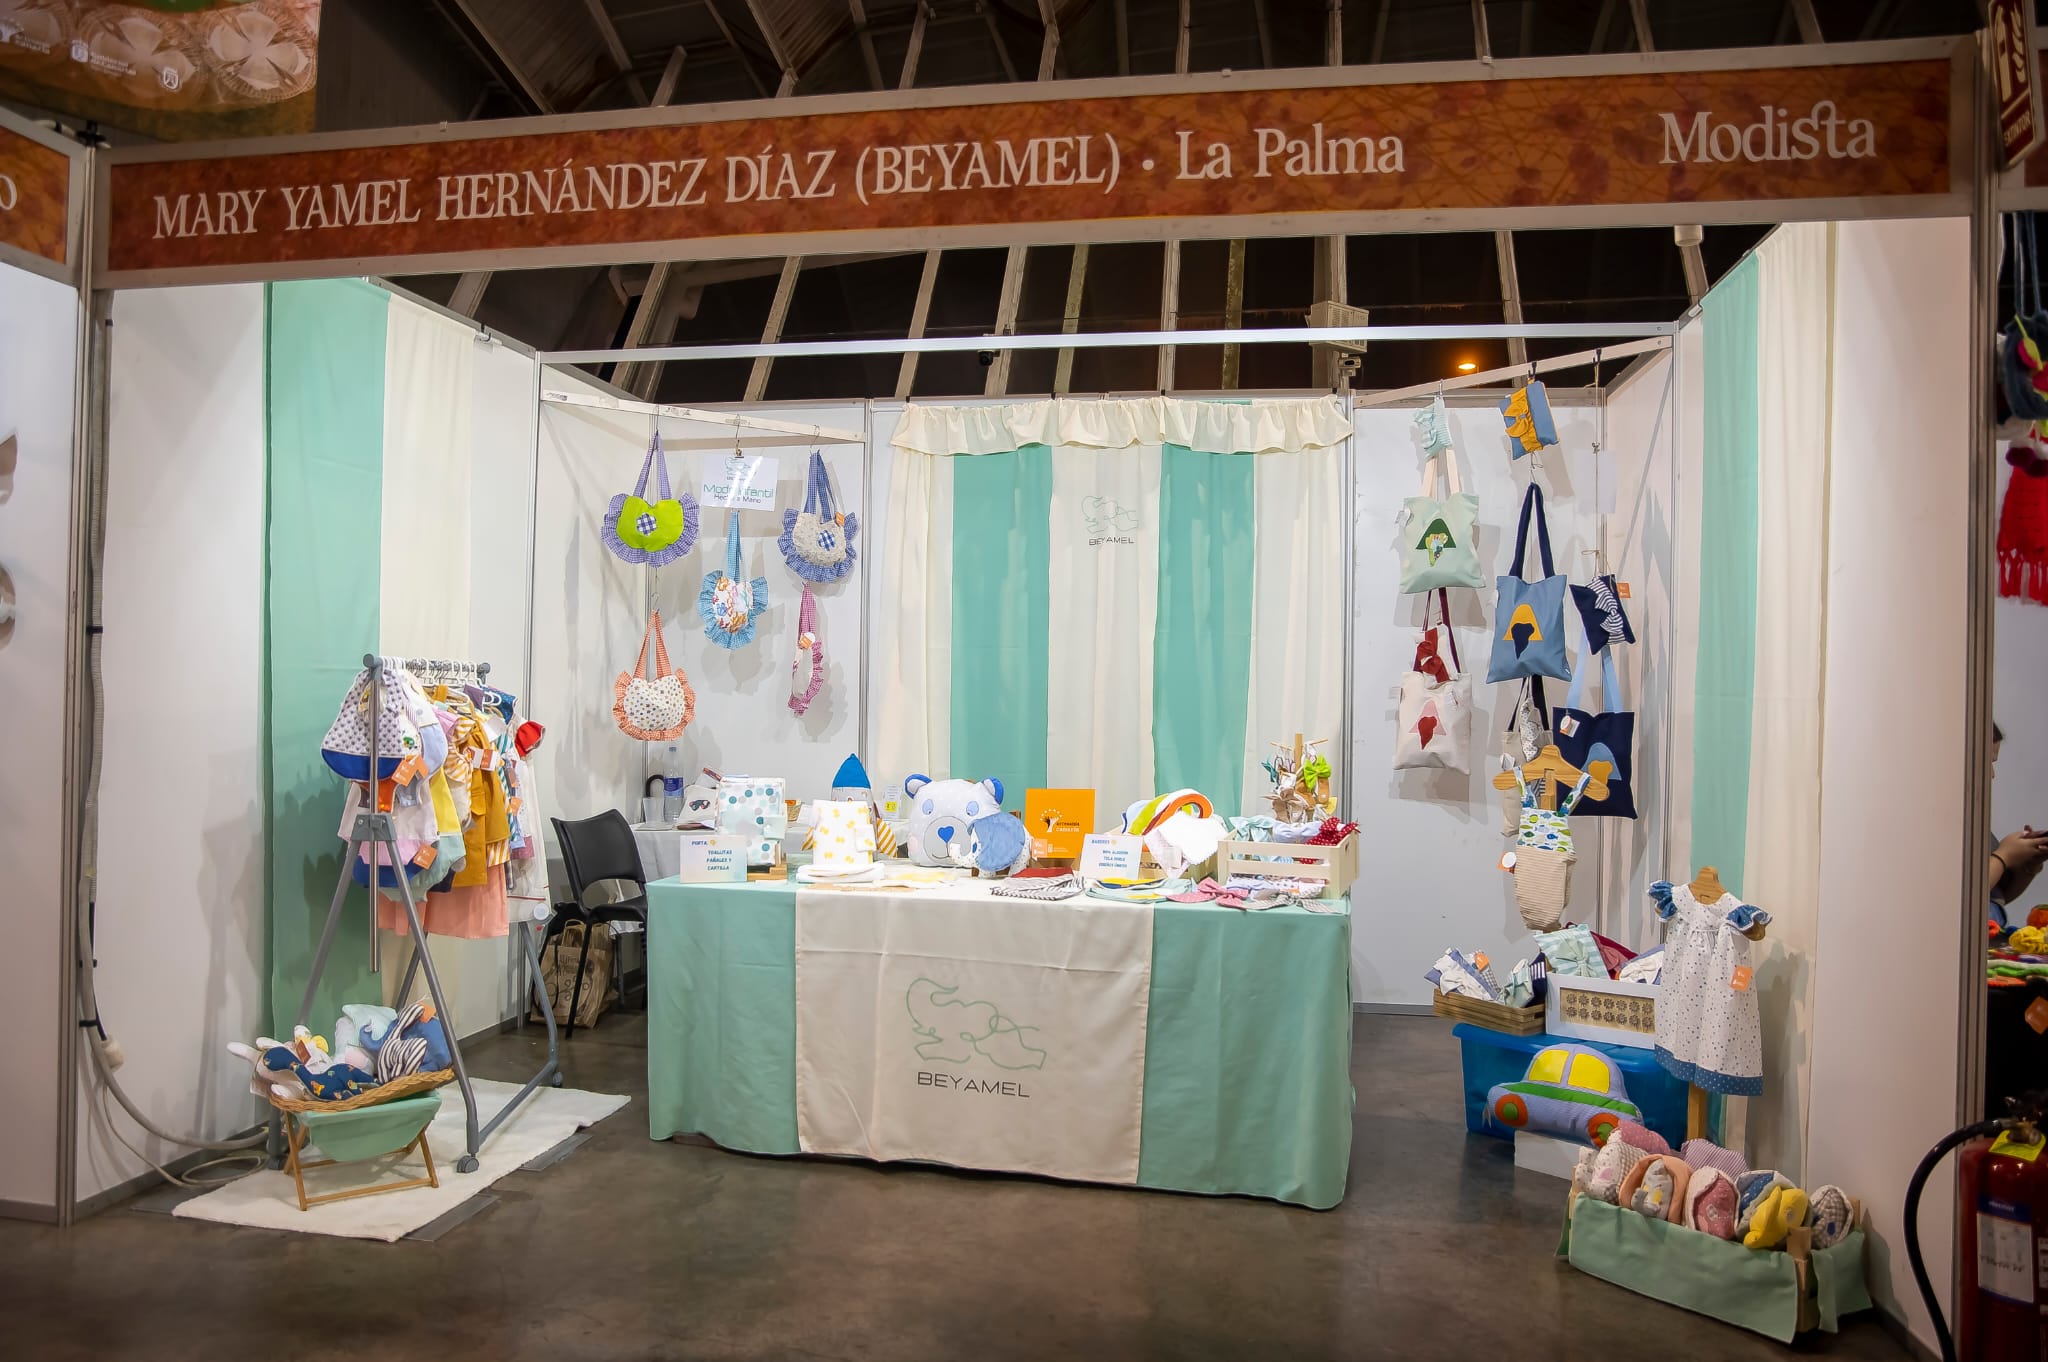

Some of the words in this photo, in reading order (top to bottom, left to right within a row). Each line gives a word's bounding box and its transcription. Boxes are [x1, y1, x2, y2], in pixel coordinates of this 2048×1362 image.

[1658, 100, 1877, 165] Modista
[153, 188, 267, 239] MARY
[281, 178, 421, 232] YAMEL
[436, 157, 708, 222] HERNÁNDEZ
[724, 144, 837, 204] DÍAZ
[855, 131, 1121, 206] (BEYAMEL)
[1175, 130, 1233, 180] La
[1254, 122, 1406, 178] Palma
[703, 484, 734, 495] Mod
[917, 1071, 1030, 1098] BEYAMEL
